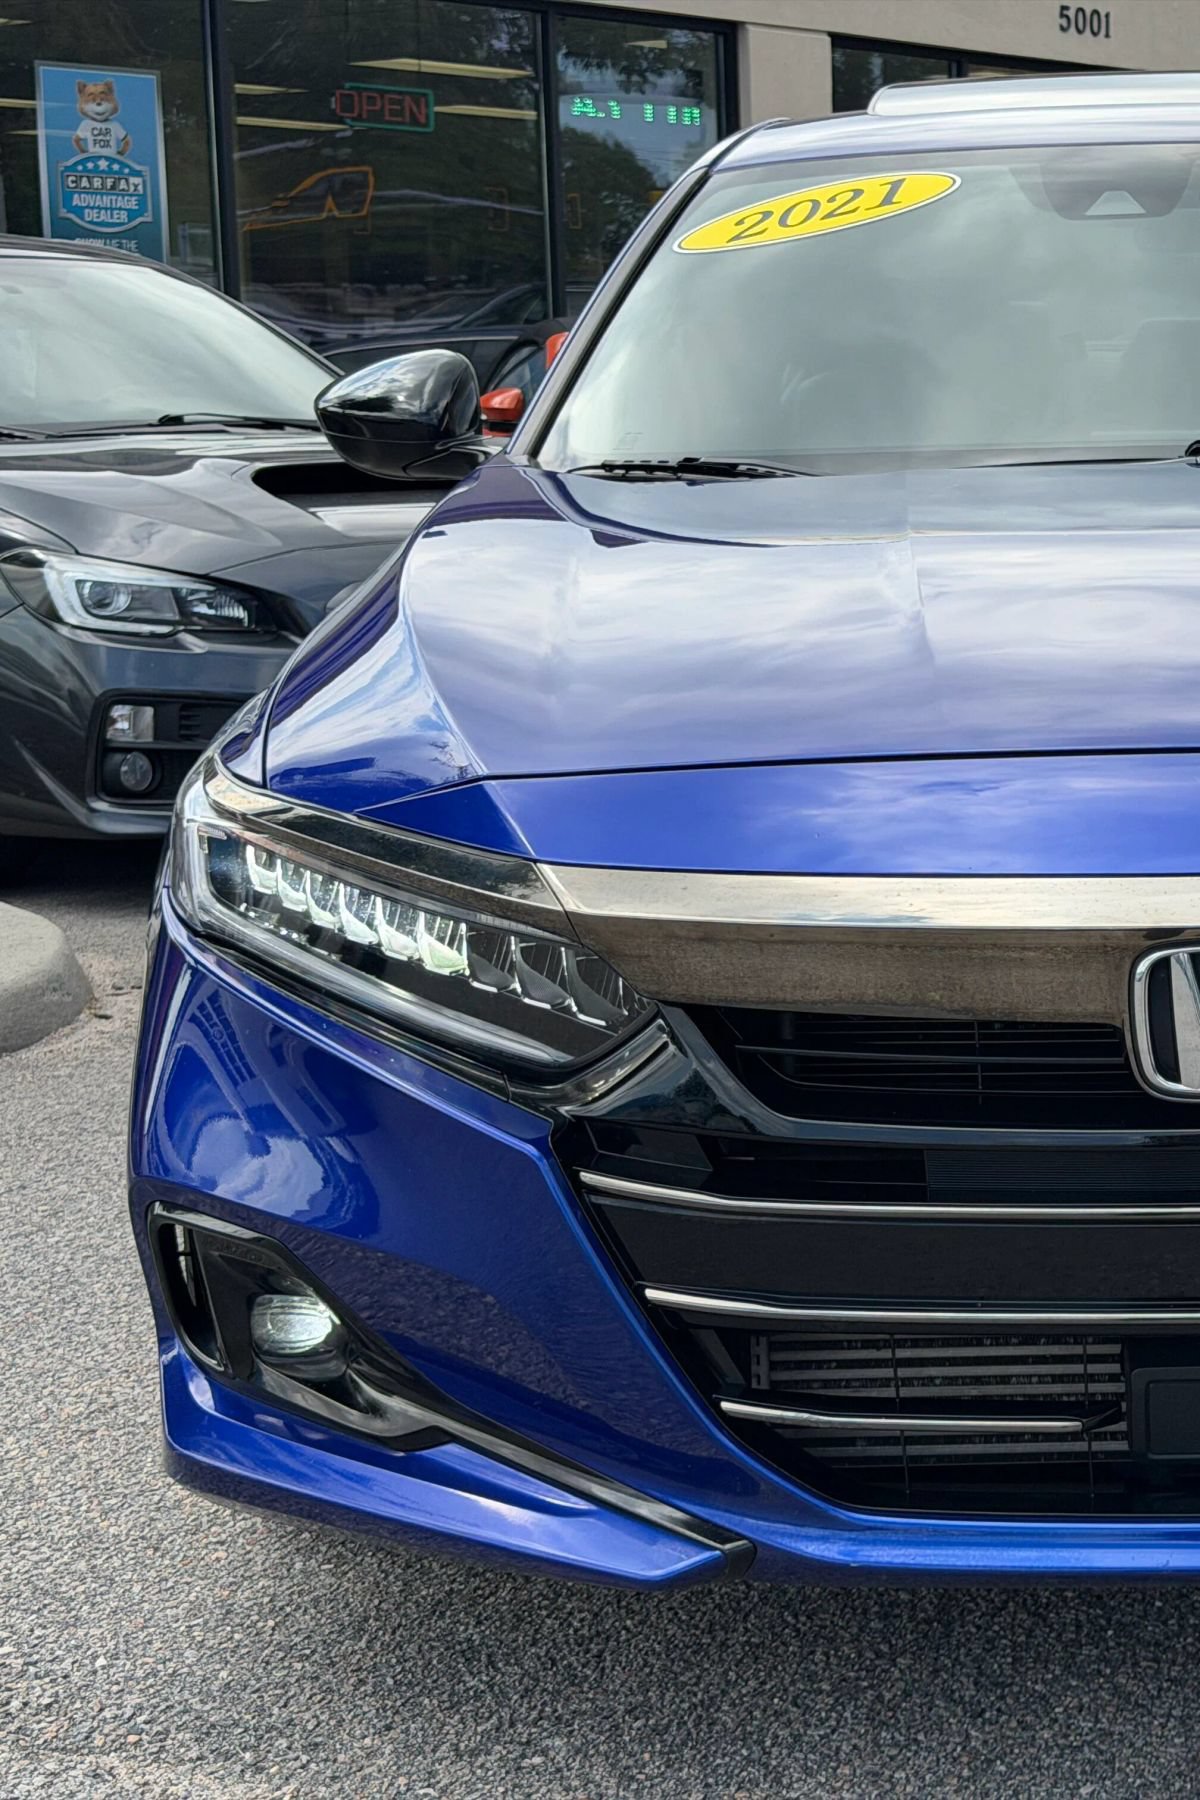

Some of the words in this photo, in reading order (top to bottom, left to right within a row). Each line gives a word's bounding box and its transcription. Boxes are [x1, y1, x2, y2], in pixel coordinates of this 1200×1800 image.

[1059, 5, 1111, 38] 5001
[336, 89, 427, 124] OPEN
[91, 127, 112, 138] CAR
[93, 139, 112, 149] FOX
[66, 175, 143, 193] CARFAX
[72, 194, 139, 209] ADVANTAGE
[84, 209, 128, 222] DEALER
[726, 177, 907, 244] 2021
[122, 239, 139, 252] THE
